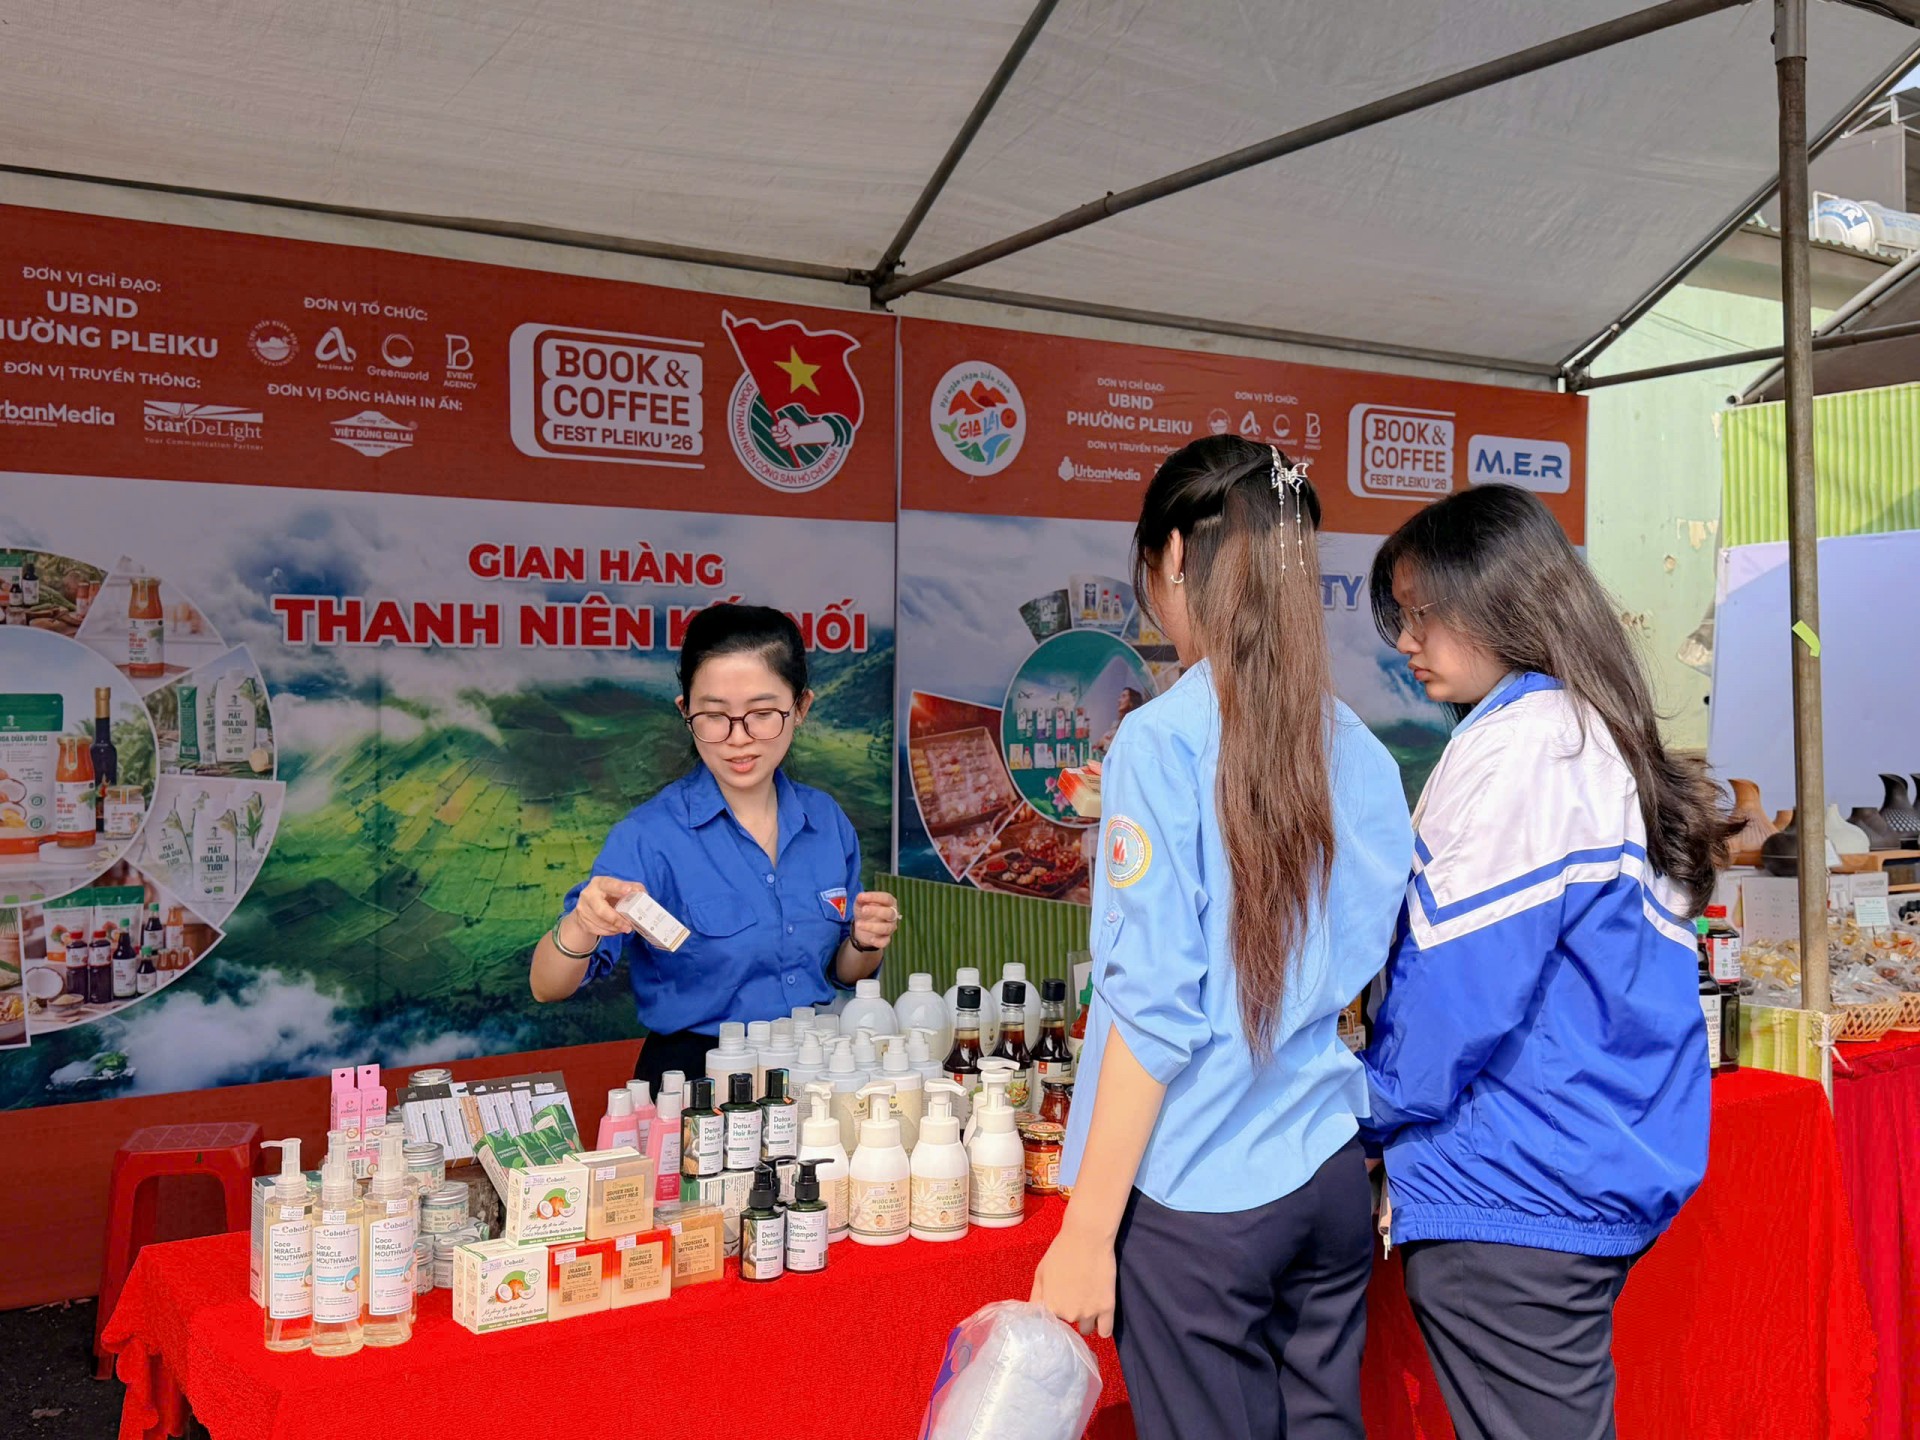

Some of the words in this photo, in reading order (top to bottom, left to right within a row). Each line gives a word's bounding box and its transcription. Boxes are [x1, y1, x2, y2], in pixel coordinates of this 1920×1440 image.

[22, 266, 62, 281] ĐƠN
[66, 271, 82, 287] VỊ
[87, 272, 116, 288] CHỈ
[120, 277, 162, 294] ĐẠO:
[47, 290, 138, 318] UBND
[304, 297, 338, 312] ĐƠN
[341, 300, 357, 316] VỊ
[384, 305, 428, 321] CHỨC:
[111, 329, 218, 358] PLEIKU
[4, 361, 44, 376] ĐƠN
[48, 364, 65, 381] VỊ
[138, 372, 200, 389] THÔNG:
[366, 366, 430, 380] Greenworld
[443, 380, 478, 390] AGENCY
[446, 371, 474, 380] EVENT
[267, 384, 303, 397] ĐƠN
[306, 386, 322, 402] VỊ
[374, 390, 416, 407] HÀNH
[420, 396, 436, 408] IN
[554, 384, 690, 427] COFFEE
[1108, 392, 1154, 410] UBND
[1066, 410, 1136, 430] PHƯỜNG
[1139, 418, 1193, 436] PLEIKU
[553, 424, 597, 443] FEST
[602, 428, 662, 448] PLEIKU
[736, 407, 746, 442] THANH
[742, 440, 757, 463] NIÊN
[754, 460, 779, 481] CỘNG
[822, 450, 840, 471] MINH
[1372, 445, 1446, 473] COFFEE
[1475, 448, 1563, 479] M.E.R
[1074, 464, 1141, 481] UrbanMedia
[1370, 474, 1394, 486] FEST
[1396, 476, 1430, 489] PLEIKU
[468, 542, 584, 580] GIAN
[600, 542, 724, 586] HÀNG
[274, 598, 498, 646] THANH
[520, 595, 651, 647] NIÊN
[704, 1134, 716, 1142] Hair
[733, 1122, 752, 1130] Detox
[790, 1231, 818, 1240] Shampoo
[316, 1256, 357, 1264] MOUTHWASH
